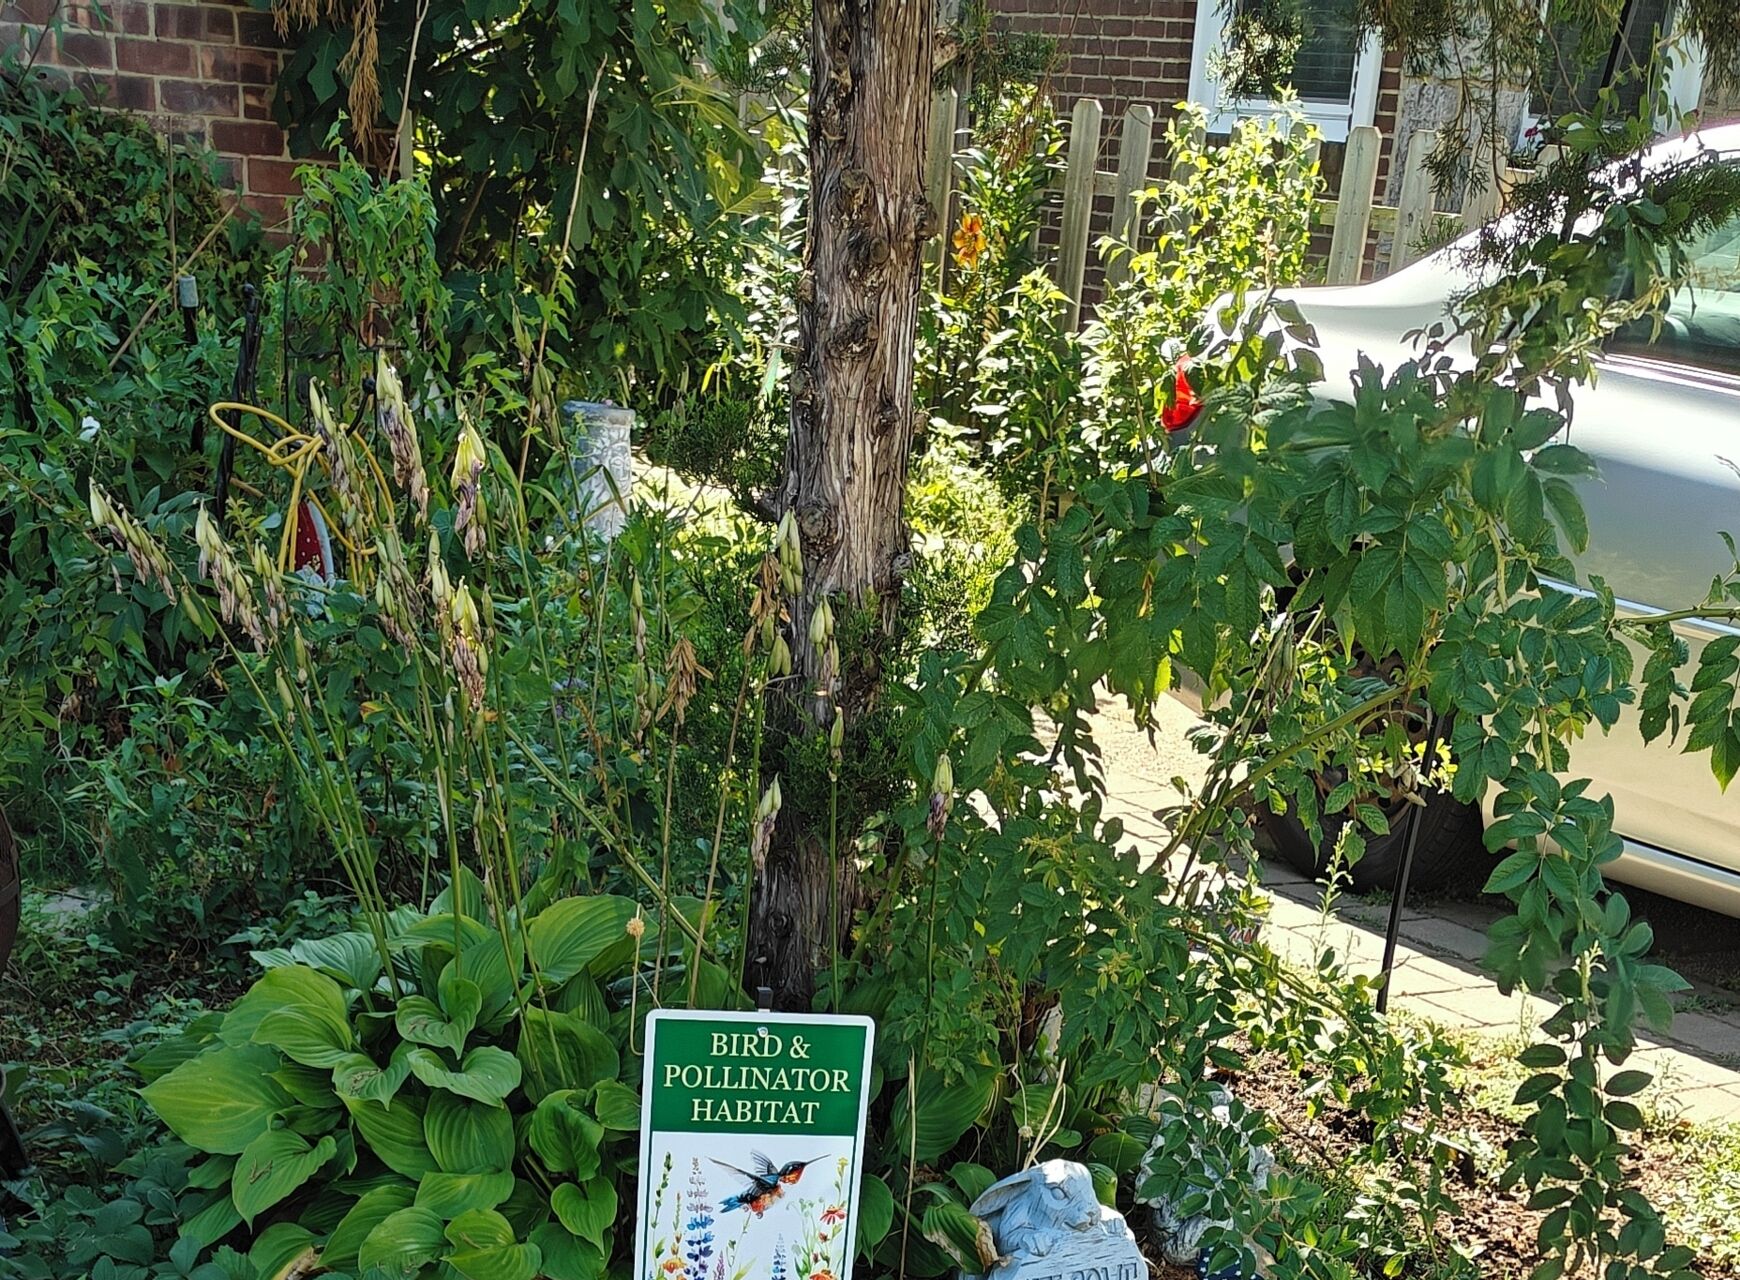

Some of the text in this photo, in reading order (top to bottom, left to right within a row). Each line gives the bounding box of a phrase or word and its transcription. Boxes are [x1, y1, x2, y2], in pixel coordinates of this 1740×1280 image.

[710, 1033, 811, 1059] BIRD &
[664, 1064, 851, 1092] POLLINATOR
[691, 1099, 820, 1125] HABITAT
